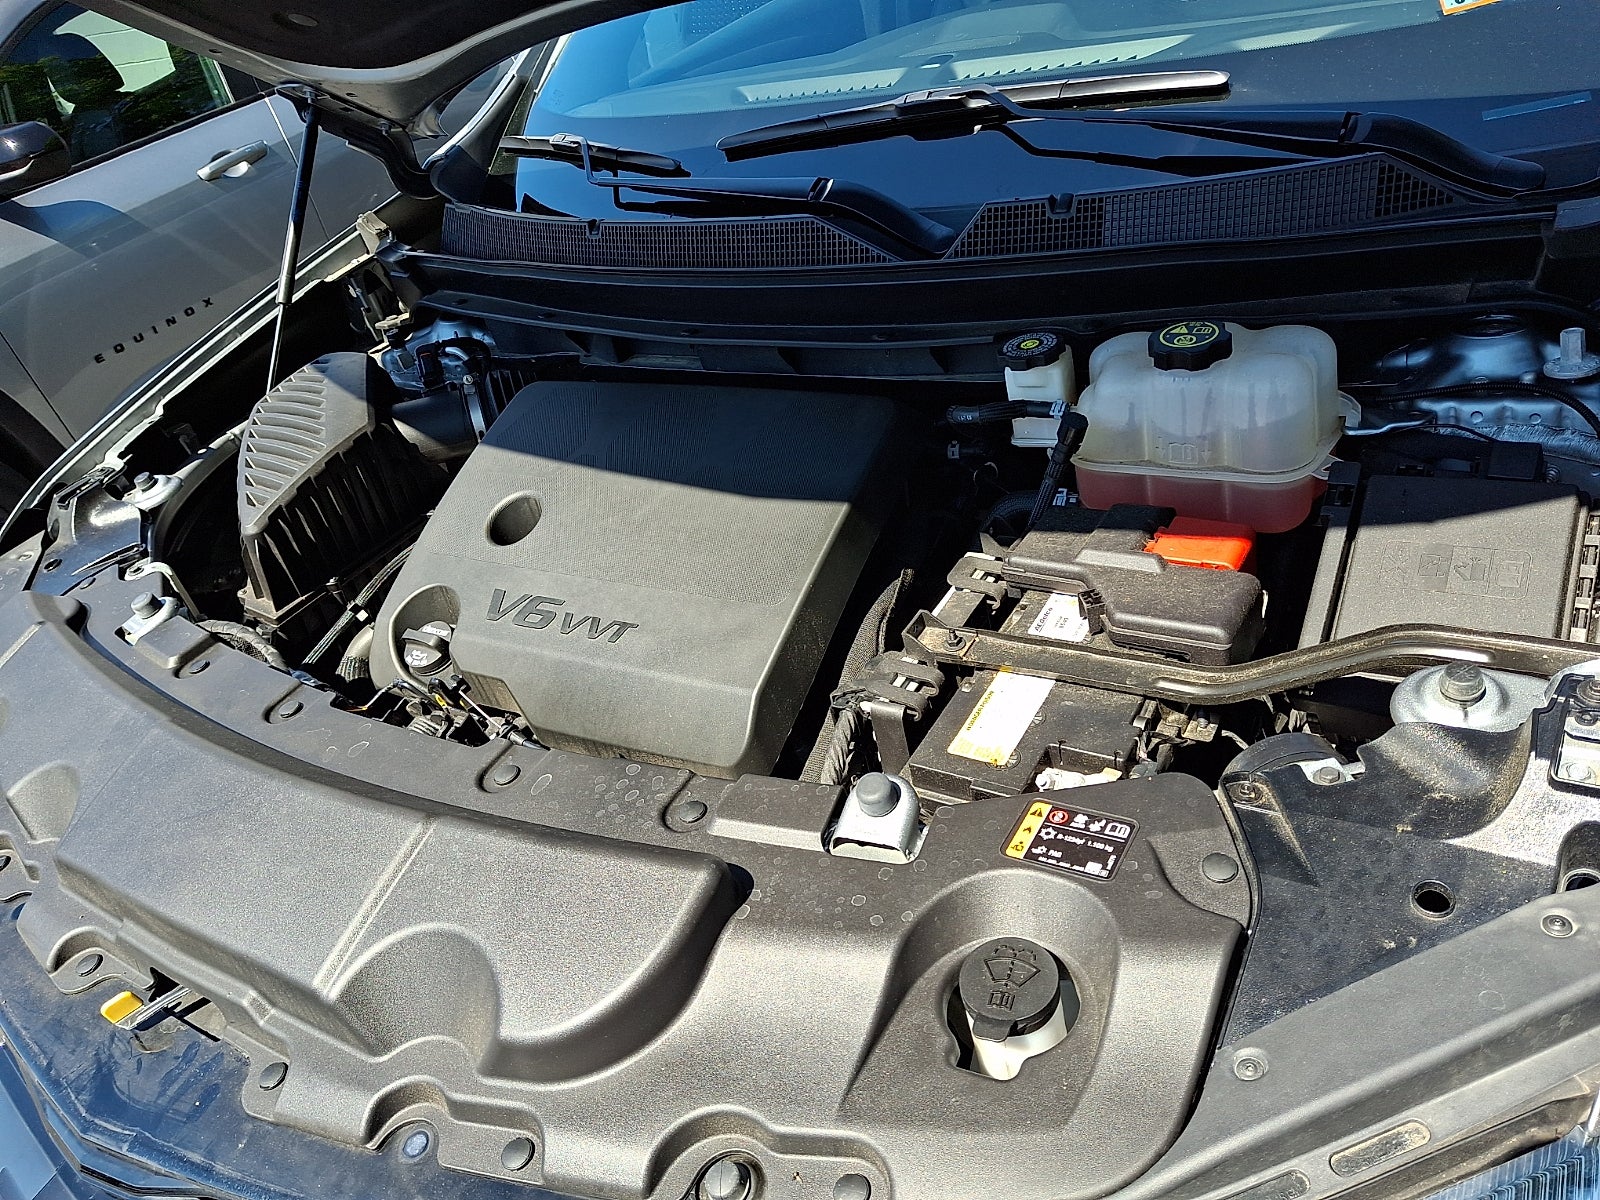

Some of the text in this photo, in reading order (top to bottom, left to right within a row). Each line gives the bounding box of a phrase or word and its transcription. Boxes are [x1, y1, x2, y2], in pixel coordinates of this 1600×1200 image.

[94, 297, 214, 364] EQUINOX
[486, 588, 639, 643] V6 VVT
